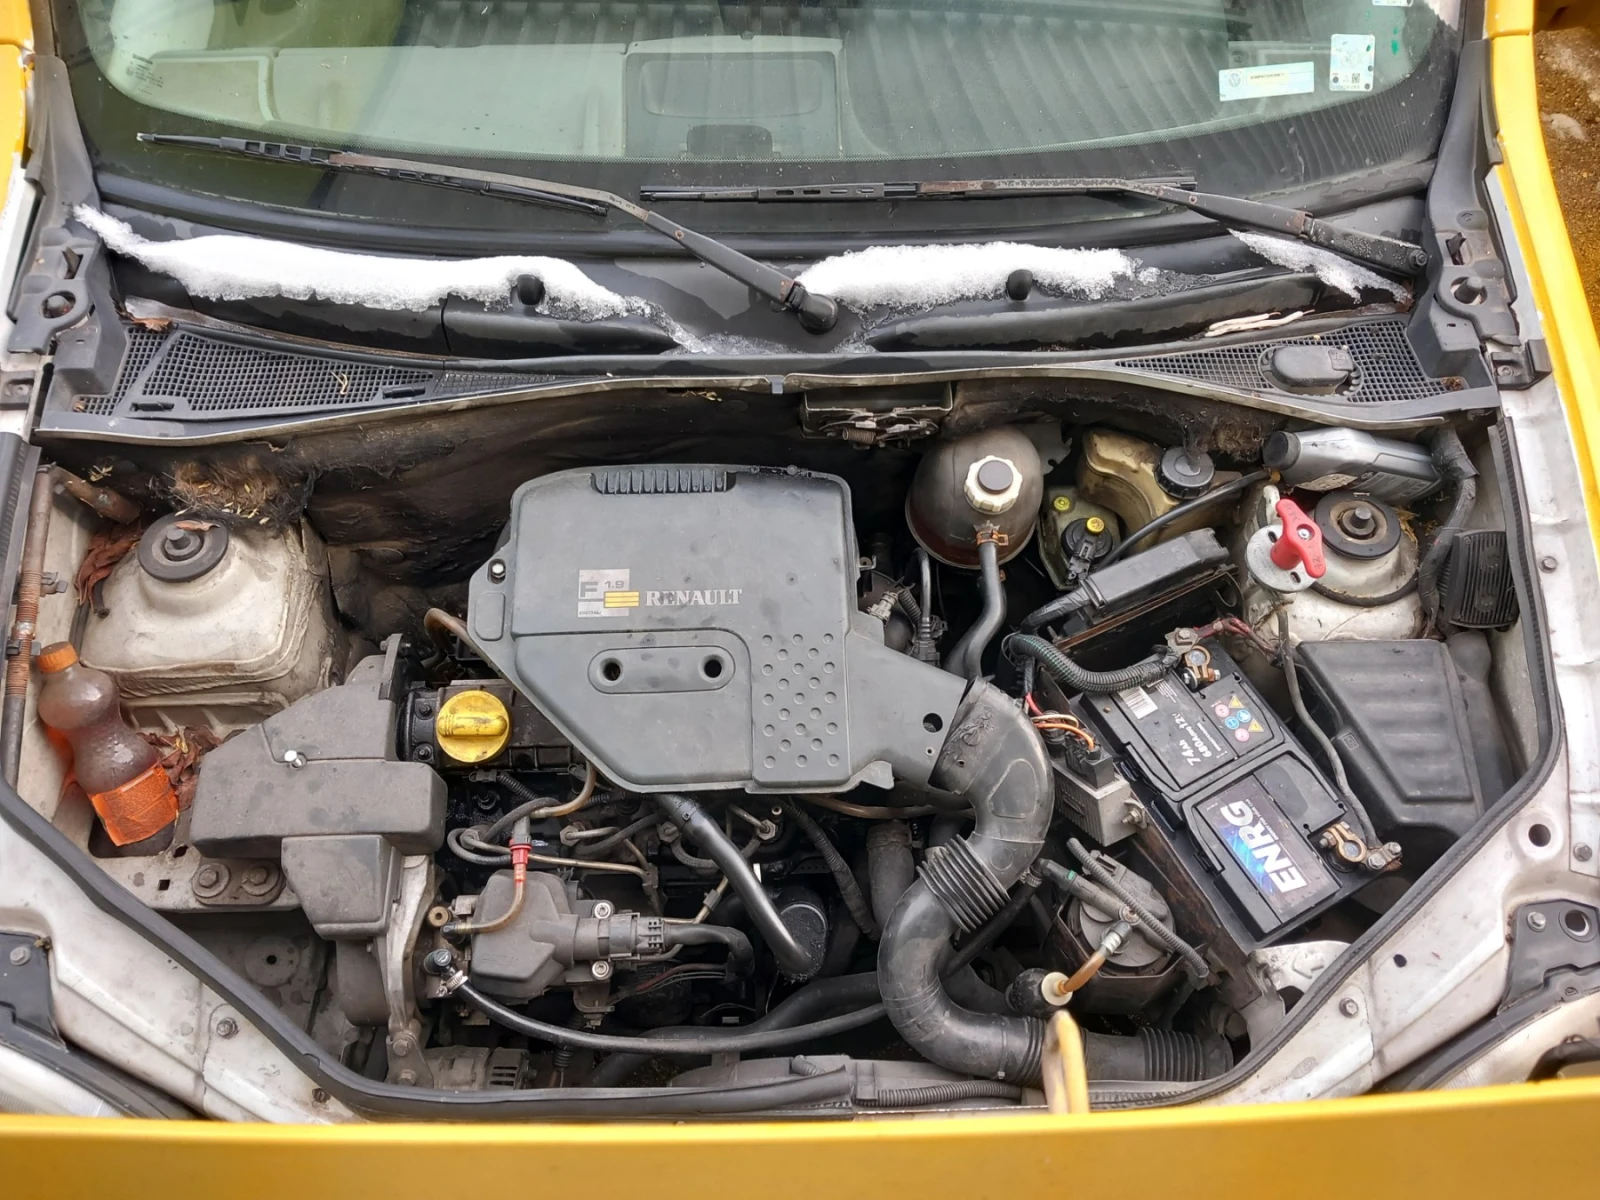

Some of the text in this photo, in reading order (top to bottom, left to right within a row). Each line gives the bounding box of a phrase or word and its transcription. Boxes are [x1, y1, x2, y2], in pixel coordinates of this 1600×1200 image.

[580, 581, 598, 597] F
[604, 580, 625, 589] 1.9
[645, 588, 743, 607] RENAULT
[1179, 738, 1201, 766] 74Ah
[1220, 800, 1307, 893] ENRG
